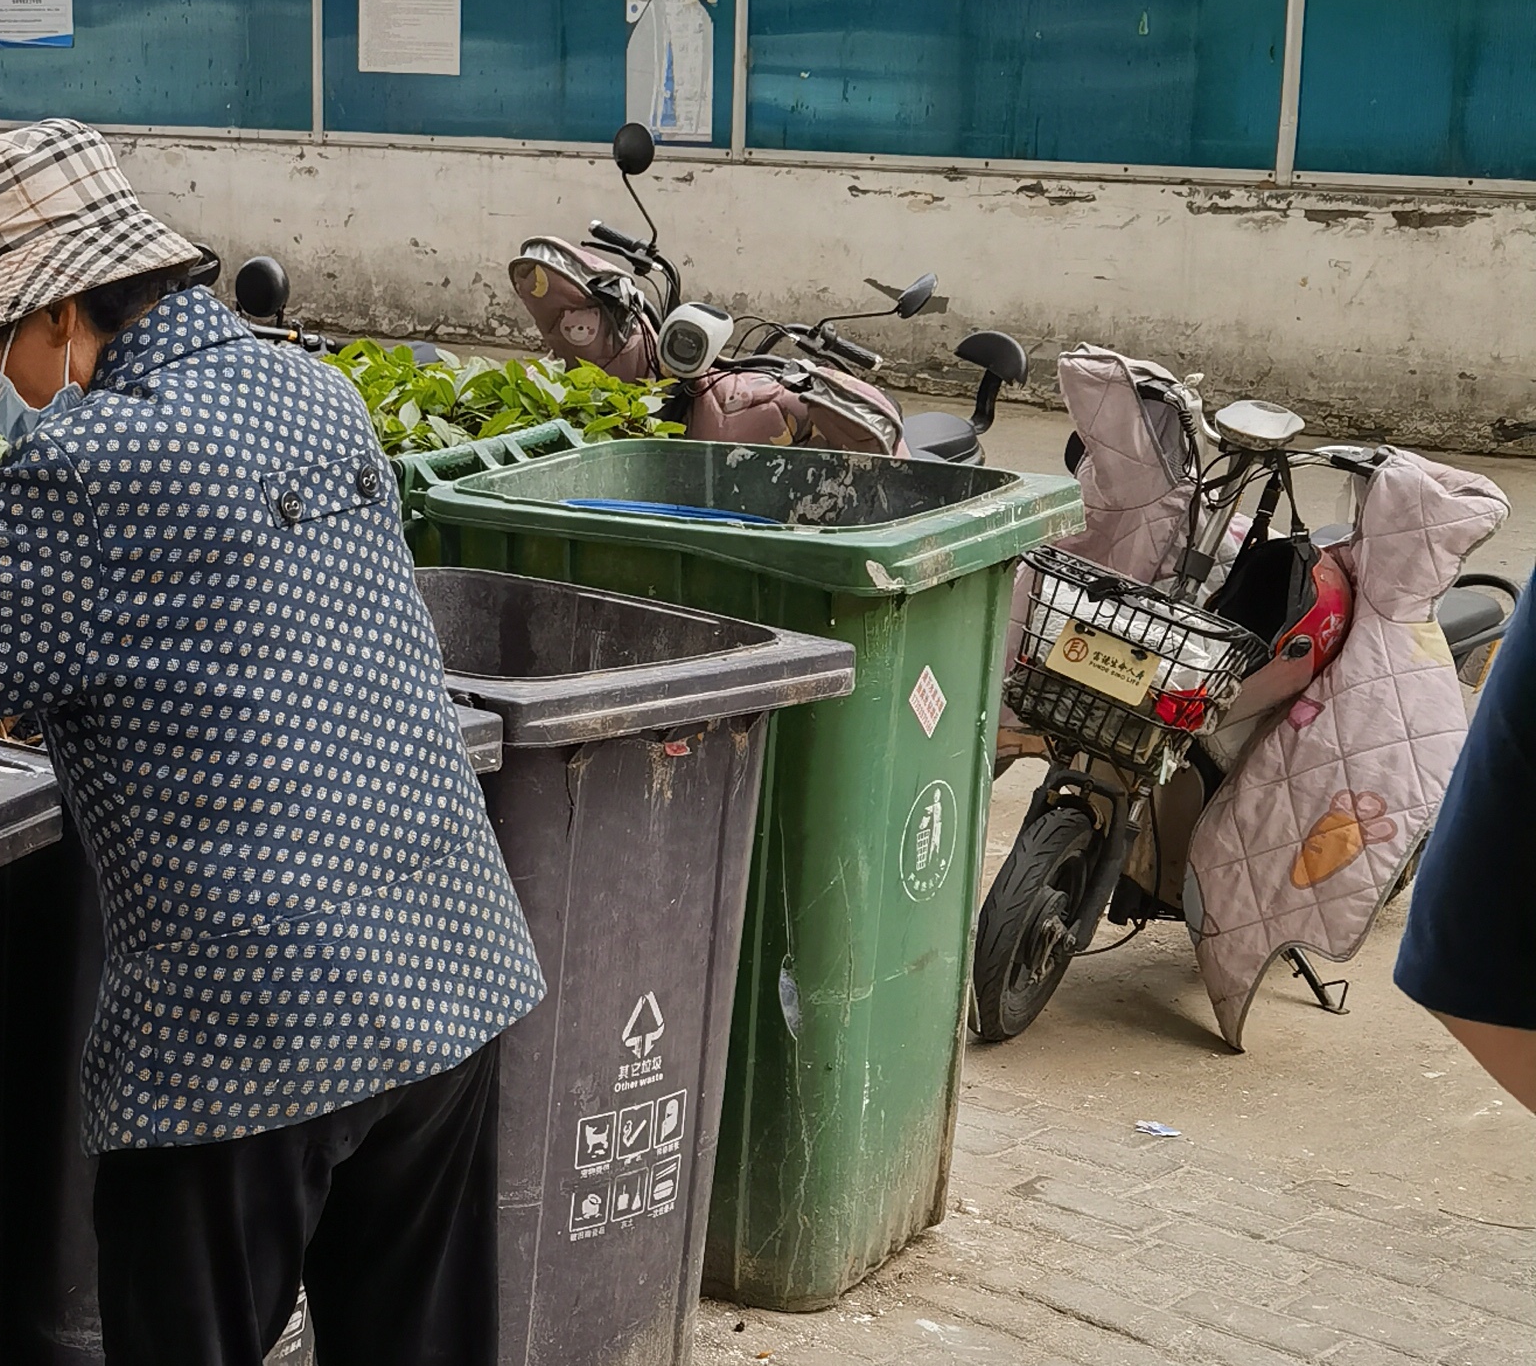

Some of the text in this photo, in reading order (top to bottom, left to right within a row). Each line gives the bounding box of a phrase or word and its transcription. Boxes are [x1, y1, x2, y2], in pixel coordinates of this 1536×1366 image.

[617, 1055, 662, 1081] 其它垃圾
[614, 1072, 664, 1093] Other waste
